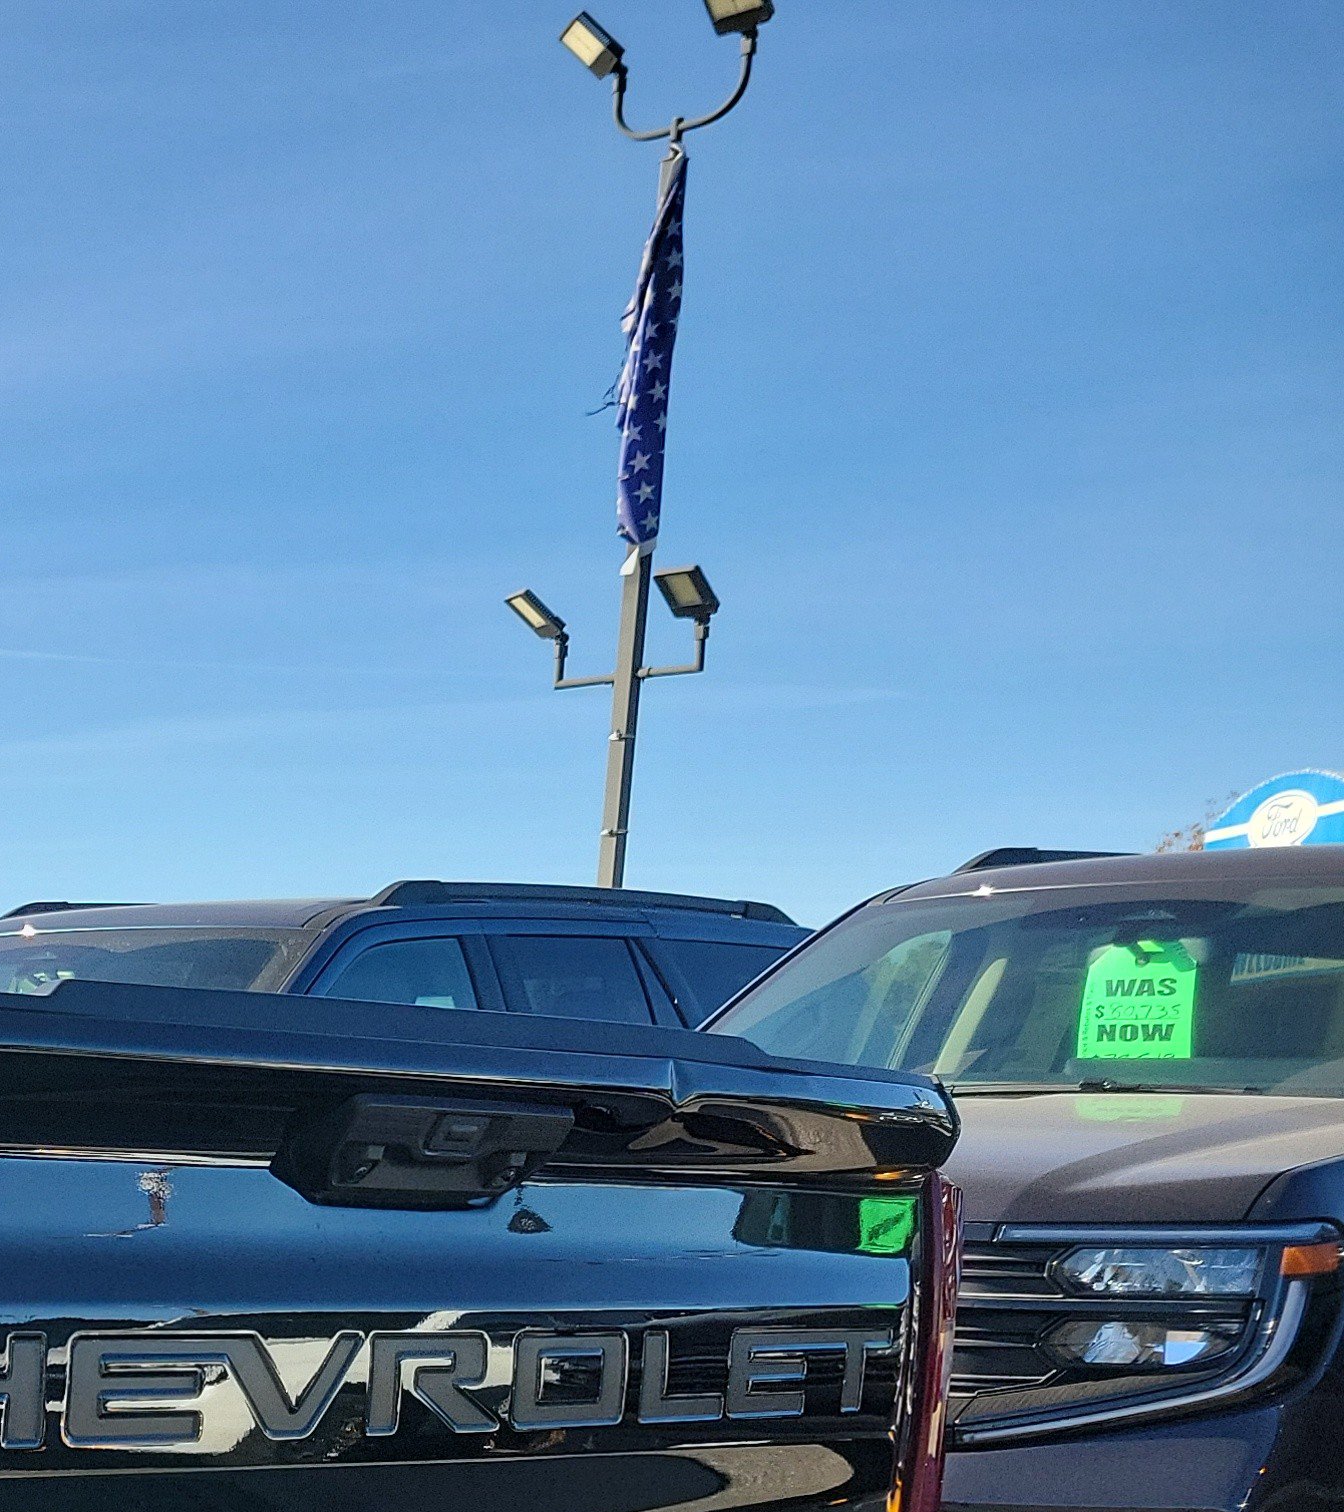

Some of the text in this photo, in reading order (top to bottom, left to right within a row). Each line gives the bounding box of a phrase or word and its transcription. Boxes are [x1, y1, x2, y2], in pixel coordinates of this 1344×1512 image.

[1261, 801, 1303, 840] Ford
[1105, 977, 1177, 998] WAS
[1096, 1023, 1176, 1043] NOW
